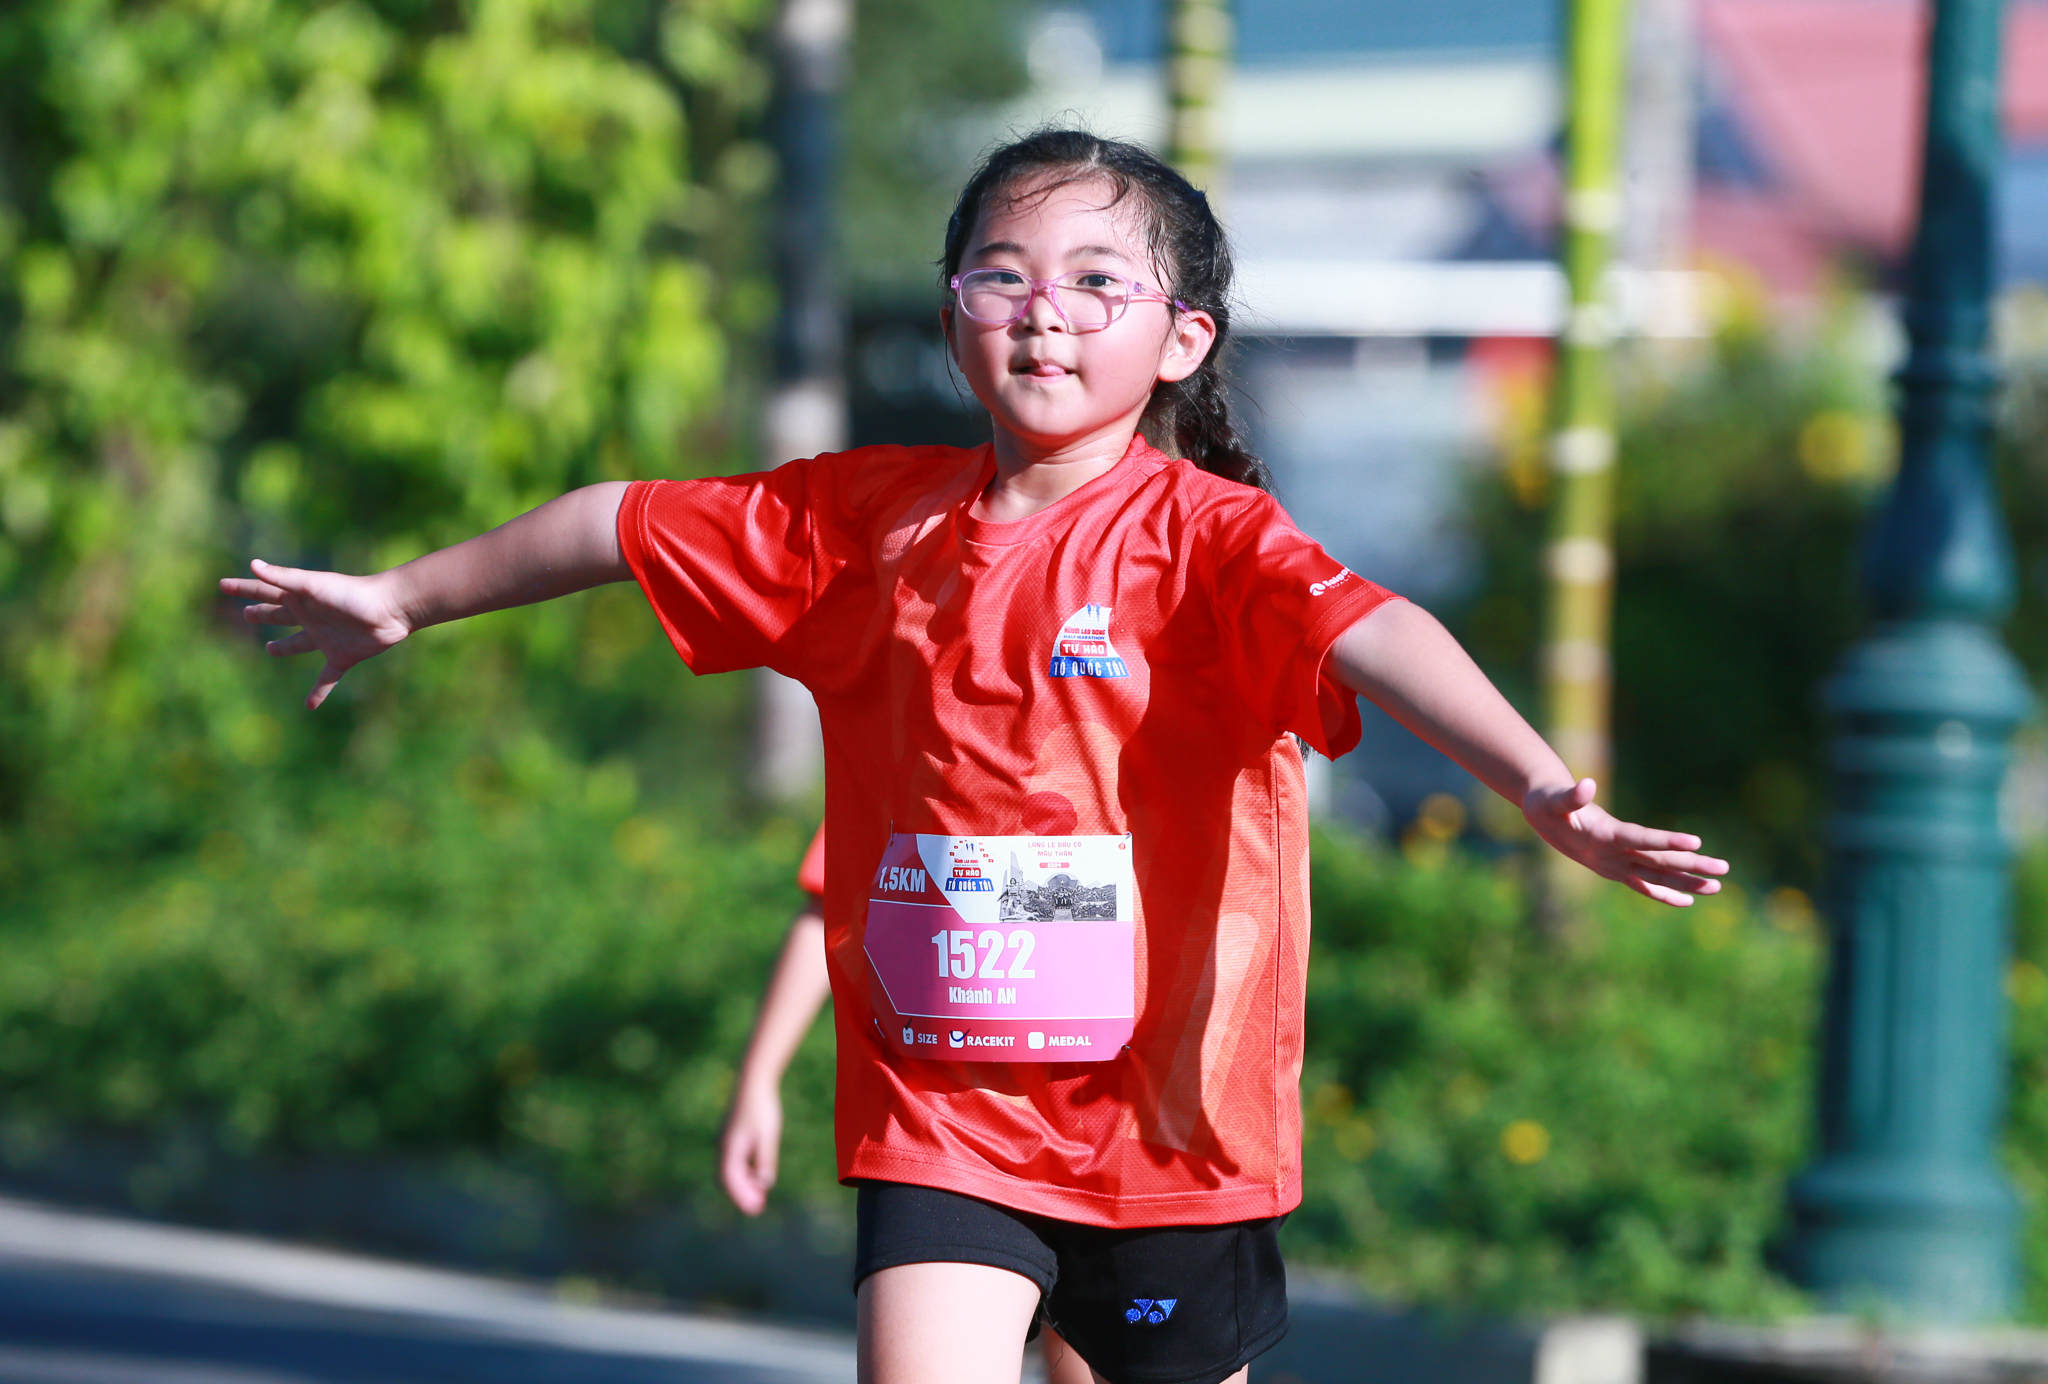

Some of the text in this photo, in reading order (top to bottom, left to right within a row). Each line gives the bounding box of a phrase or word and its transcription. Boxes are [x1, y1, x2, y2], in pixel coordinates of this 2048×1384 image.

[1063, 641, 1105, 655] TỰ HÀO
[1072, 659, 1102, 677] QUỐC
[954, 867, 980, 877] TỰ HÀO
[879, 866, 926, 893] 1,5KM
[958, 878, 977, 891] QUỐC
[932, 929, 1036, 979] 1522
[948, 986, 1017, 1004] Khánh AN
[917, 1033, 938, 1045] SIZE
[966, 1035, 1016, 1047] RACEKIT
[1048, 1035, 1092, 1047] MEDAL
